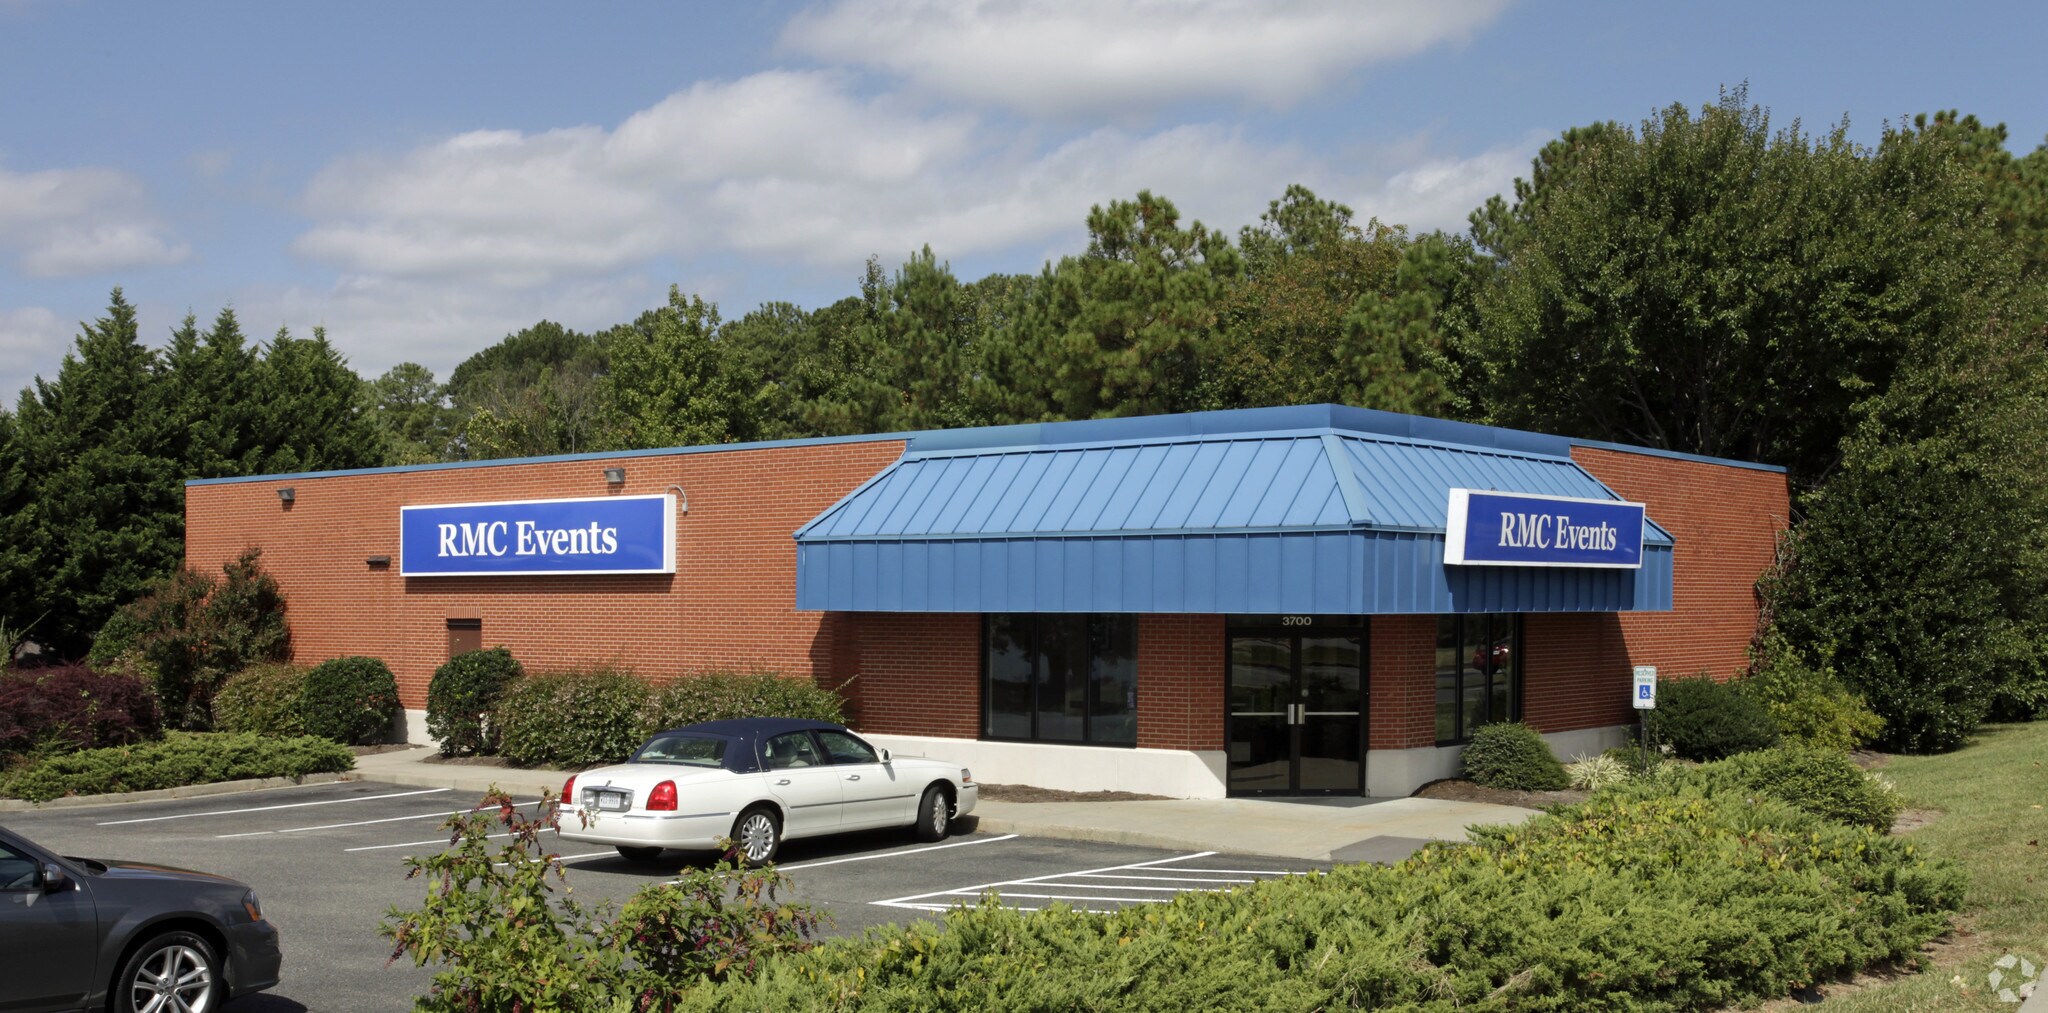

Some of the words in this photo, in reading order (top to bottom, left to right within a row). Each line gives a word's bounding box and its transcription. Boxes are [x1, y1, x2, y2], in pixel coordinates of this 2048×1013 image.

[437, 521, 508, 557] RMC
[515, 520, 618, 556] Events
[1498, 512, 1551, 549] RMC
[1554, 515, 1617, 551] Events
[1282, 616, 1312, 626] 3700
